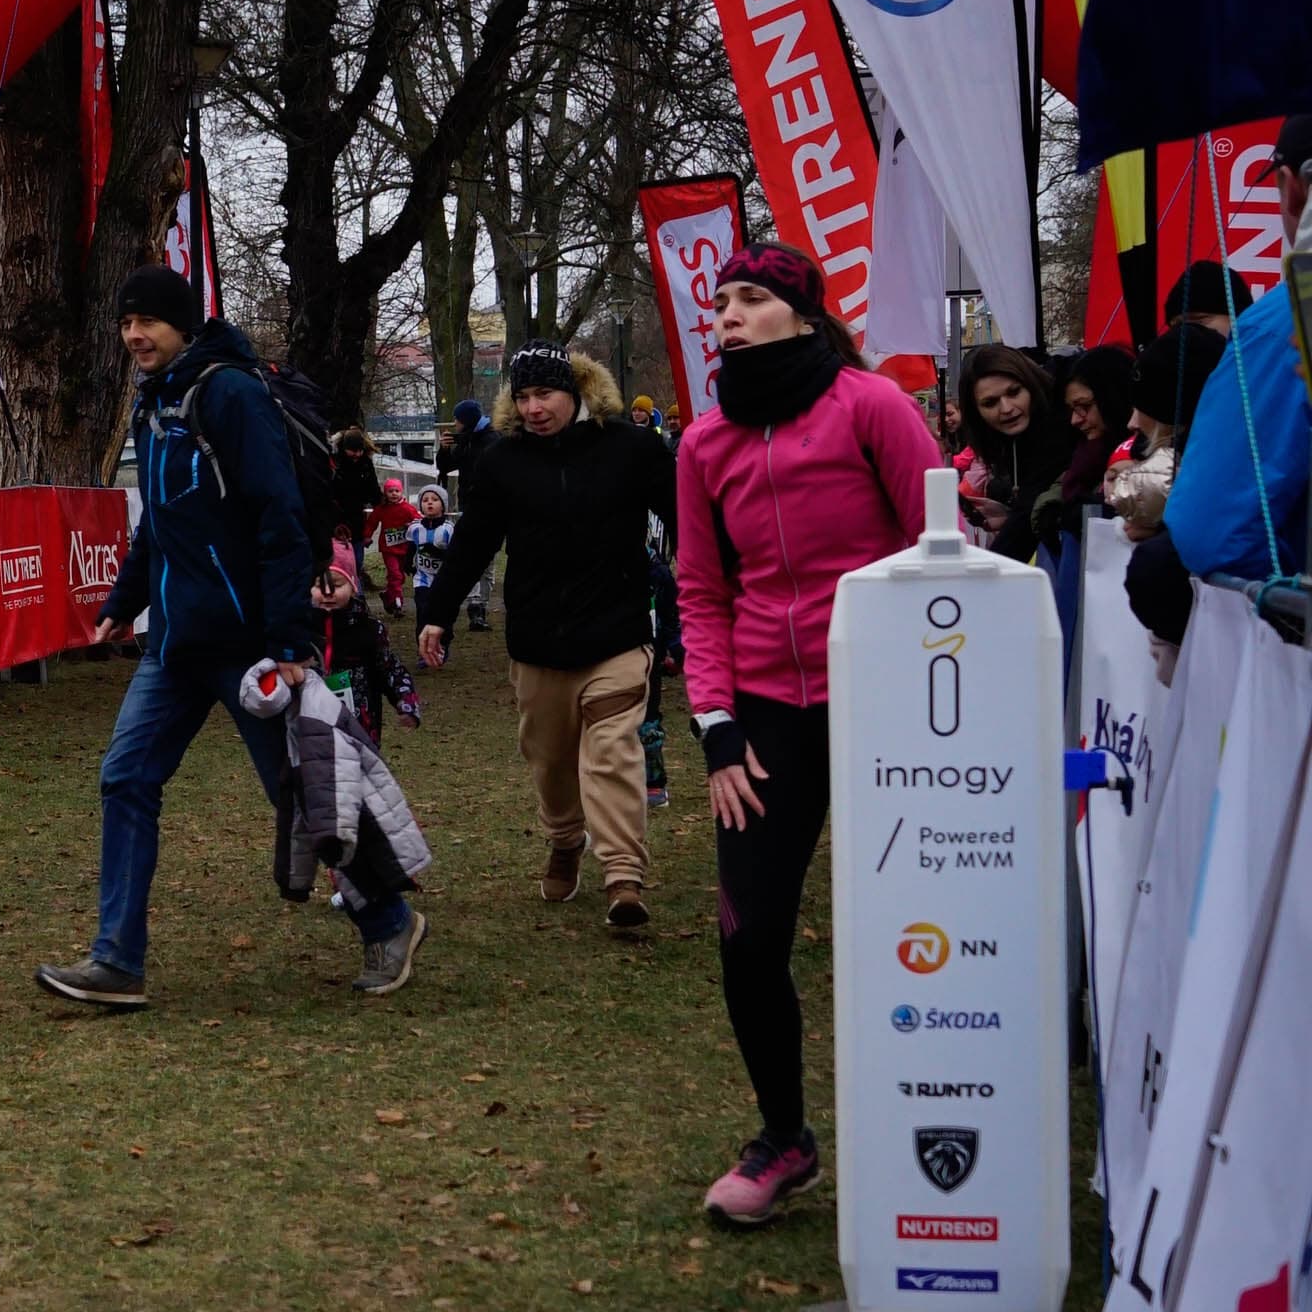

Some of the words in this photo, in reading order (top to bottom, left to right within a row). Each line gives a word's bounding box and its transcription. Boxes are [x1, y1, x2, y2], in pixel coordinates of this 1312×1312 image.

[875, 758, 1014, 794] innogy
[920, 826, 1015, 844] Powered
[920, 851, 946, 872] by
[956, 852, 1014, 868] MVM
[960, 940, 997, 957] NN
[925, 1008, 1001, 1030] ŠKODA
[916, 1083, 995, 1098] RUNTO
[901, 1219, 995, 1237] NUTREND
